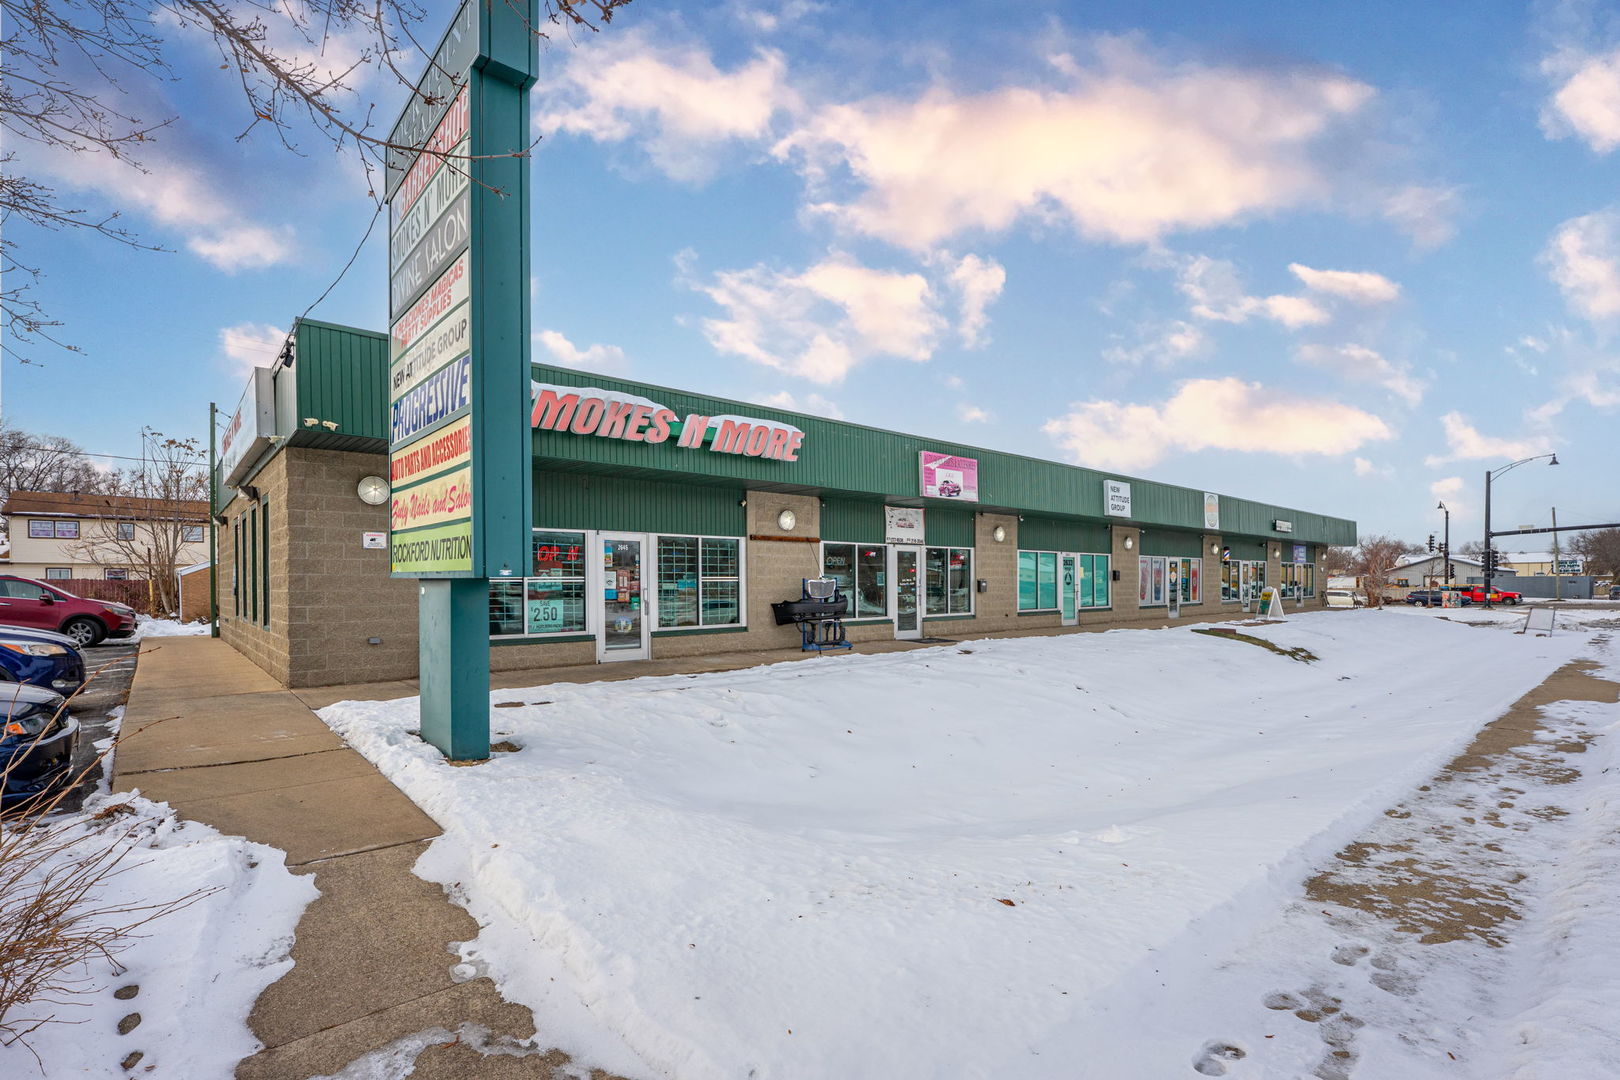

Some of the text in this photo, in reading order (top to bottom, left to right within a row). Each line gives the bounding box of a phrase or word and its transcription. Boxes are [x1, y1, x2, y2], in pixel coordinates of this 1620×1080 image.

[391, 210, 421, 272] SMOKES
[437, 147, 466, 214] MORE
[392, 199, 467, 310] DIVINE SALON
[431, 259, 463, 301] MAGICAS
[420, 289, 452, 331] SUPPLIES
[393, 319, 467, 391] NEW ATTITUDE GROUP
[392, 355, 470, 443] PROGRESSIVE
[531, 389, 675, 443] MOKES
[710, 419, 805, 462] MORE
[392, 424, 470, 481] AUTO PARTS AND ACCESSORIES
[433, 489, 448, 513] and
[448, 483, 471, 513] Salon
[1111, 495, 1130, 503] ATTITUDE
[1111, 503, 1126, 512] GROUP
[393, 540, 429, 563] ROCKFORD
[431, 535, 471, 561] NUTRITION
[538, 546, 579, 561] OPN
[826, 556, 846, 566] OPEN
